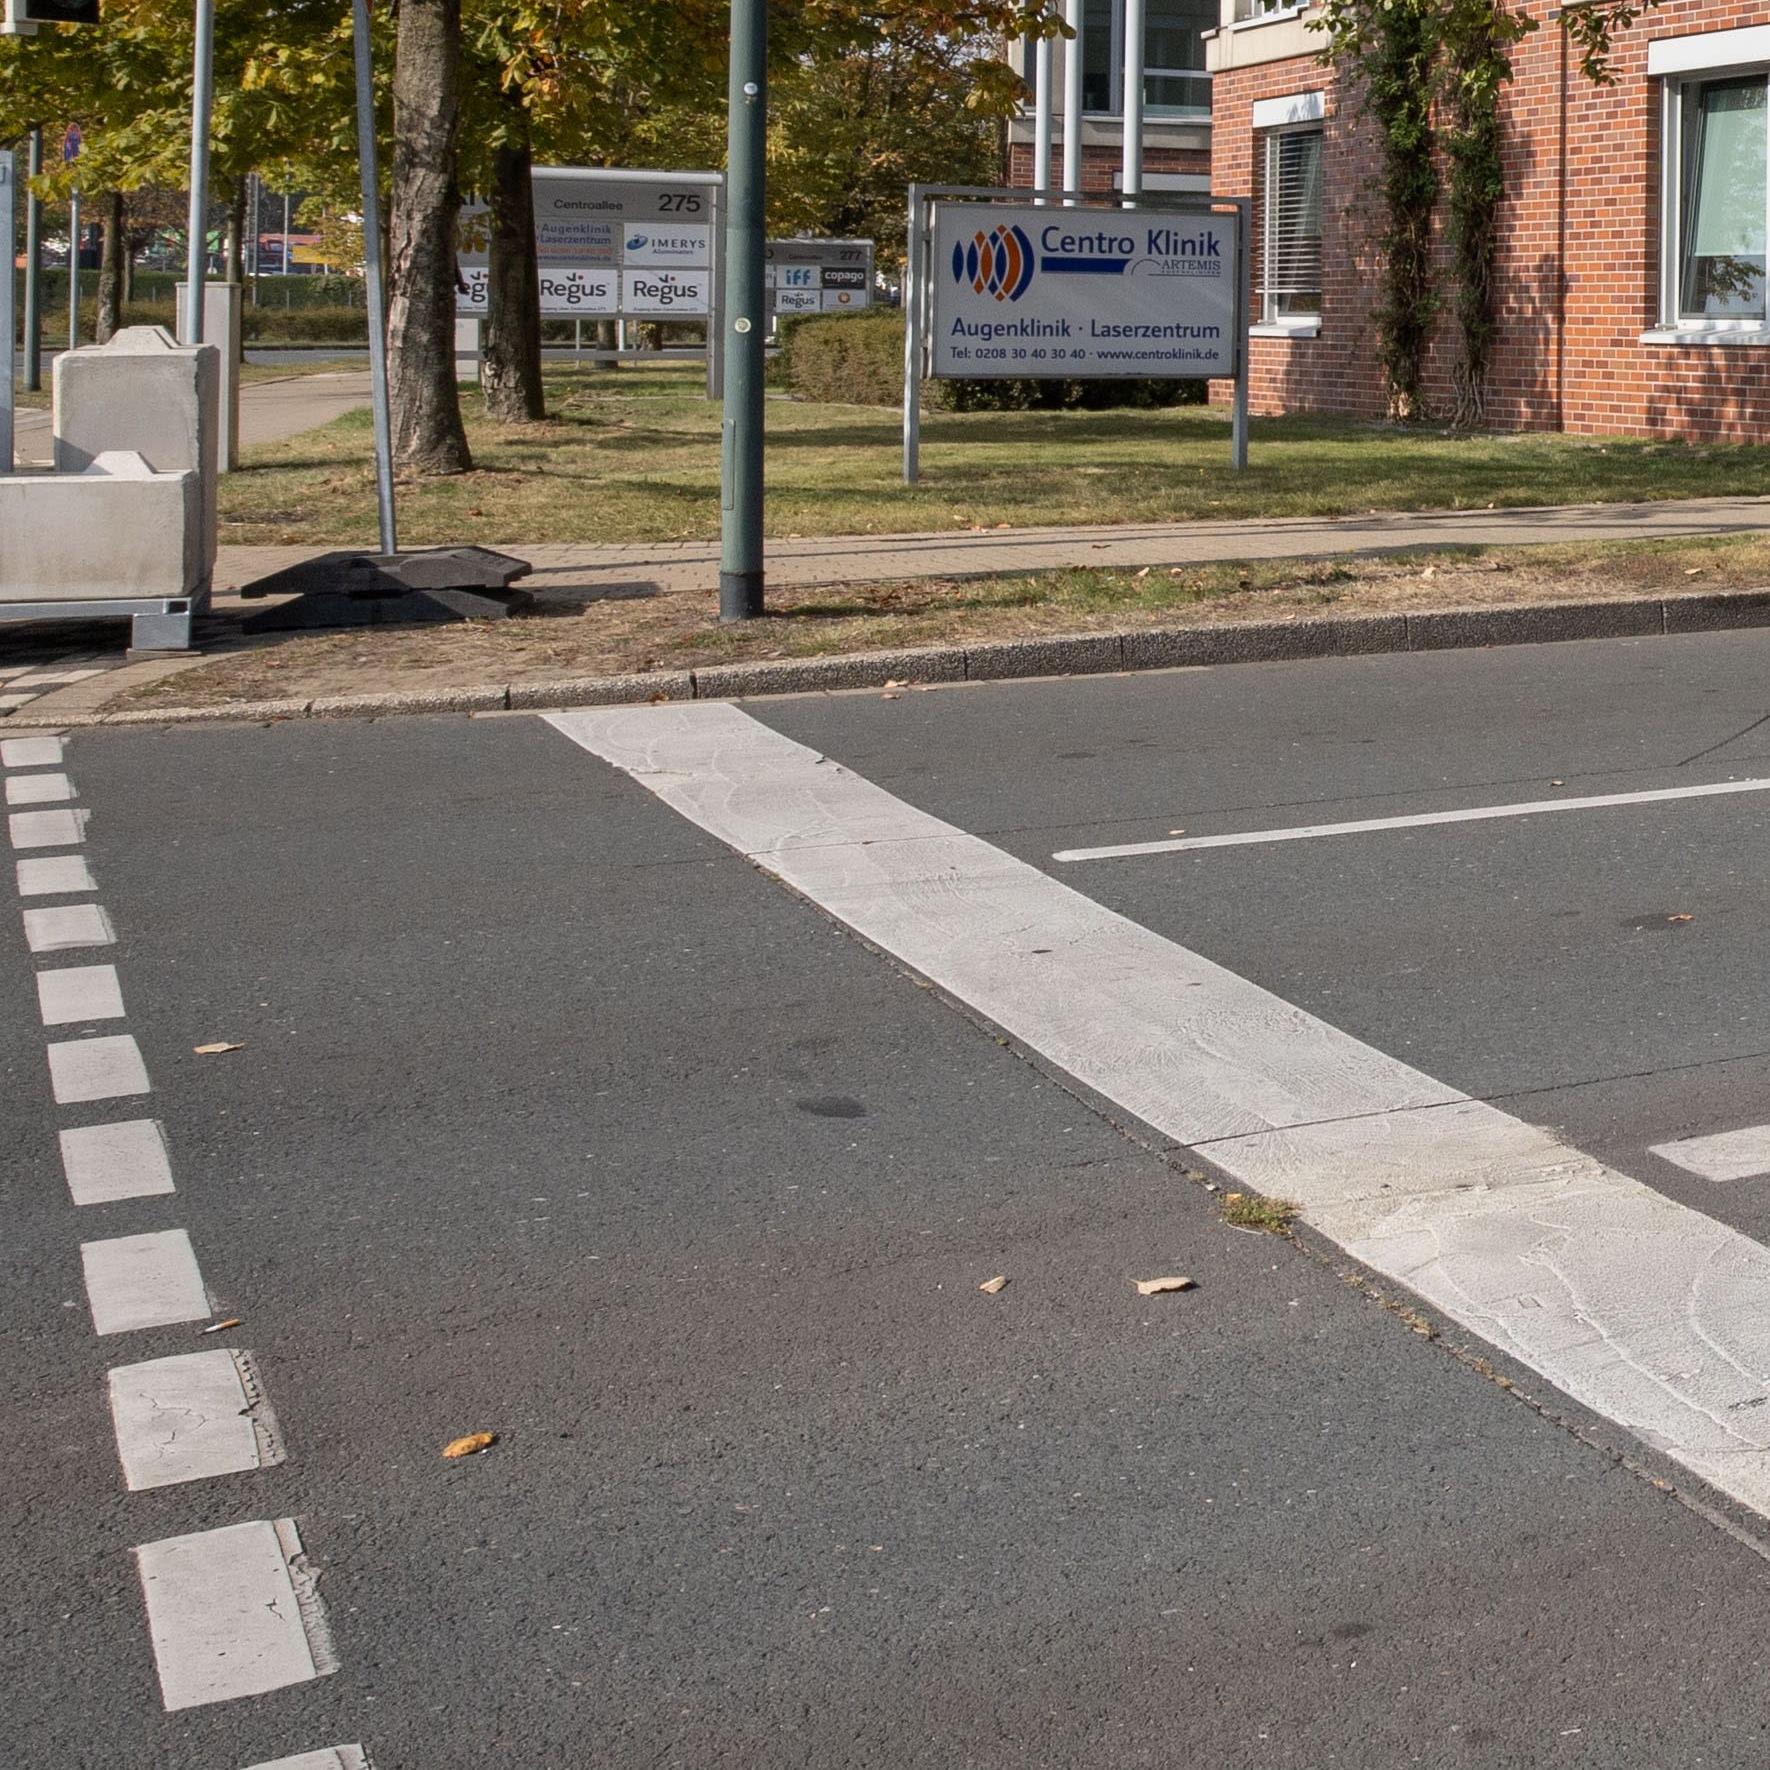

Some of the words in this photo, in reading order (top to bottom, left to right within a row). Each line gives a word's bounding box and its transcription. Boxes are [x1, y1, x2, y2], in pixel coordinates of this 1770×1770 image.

[554, 198, 624, 211] Centroallee
[658, 194, 701, 212] 275
[542, 223, 611, 235] Augenklinik
[651, 238, 706, 249] IMERYS
[1041, 226, 1135, 255] Centro
[1148, 229, 1220, 257] Klinik
[840, 251, 862, 261] 277
[1162, 259, 1221, 271] ARTEMIS
[786, 269, 811, 286] iff
[825, 271, 864, 283] copago
[540, 279, 607, 304] Regus
[633, 280, 698, 305] Regus
[781, 294, 815, 308] Regus
[951, 318, 1071, 341] Augenklinik
[1091, 319, 1220, 339] Laserzentrum
[951, 346, 972, 359] Tel:
[975, 347, 1007, 360] 0208
[1011, 347, 1027, 360] 30
[1031, 347, 1047, 360] 40
[1051, 347, 1067, 360] 30
[1070, 347, 1086, 360] 40
[1097, 347, 1220, 361] www.centroklinik.de
